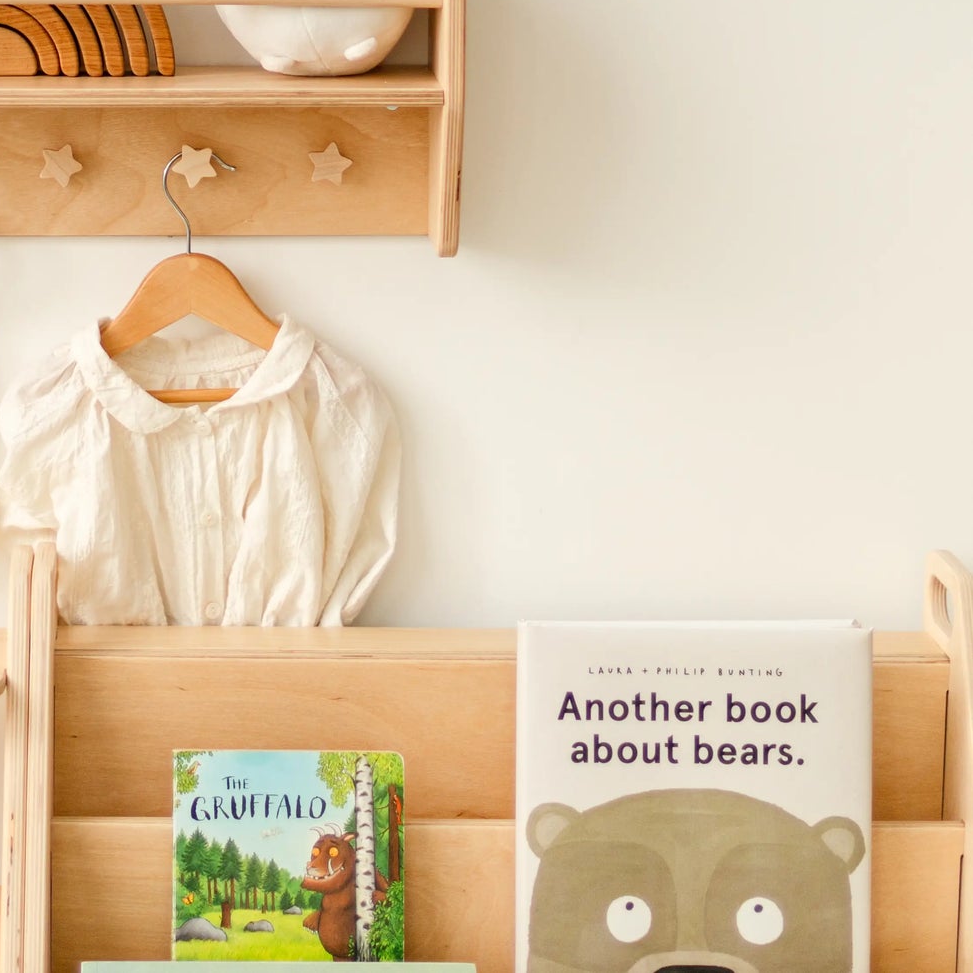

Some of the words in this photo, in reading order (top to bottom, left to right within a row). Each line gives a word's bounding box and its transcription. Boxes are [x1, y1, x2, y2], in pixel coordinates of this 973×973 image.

[588, 667, 633, 675] LAURA
[657, 667, 704, 675] PHILIP
[718, 668, 782, 676] BUNTING
[558, 692, 712, 721] Another
[727, 693, 818, 723] book
[571, 734, 678, 764] about
[694, 735, 804, 765] bears.
[222, 776, 249, 790] THE
[190, 794, 327, 821] GRUFFALO
